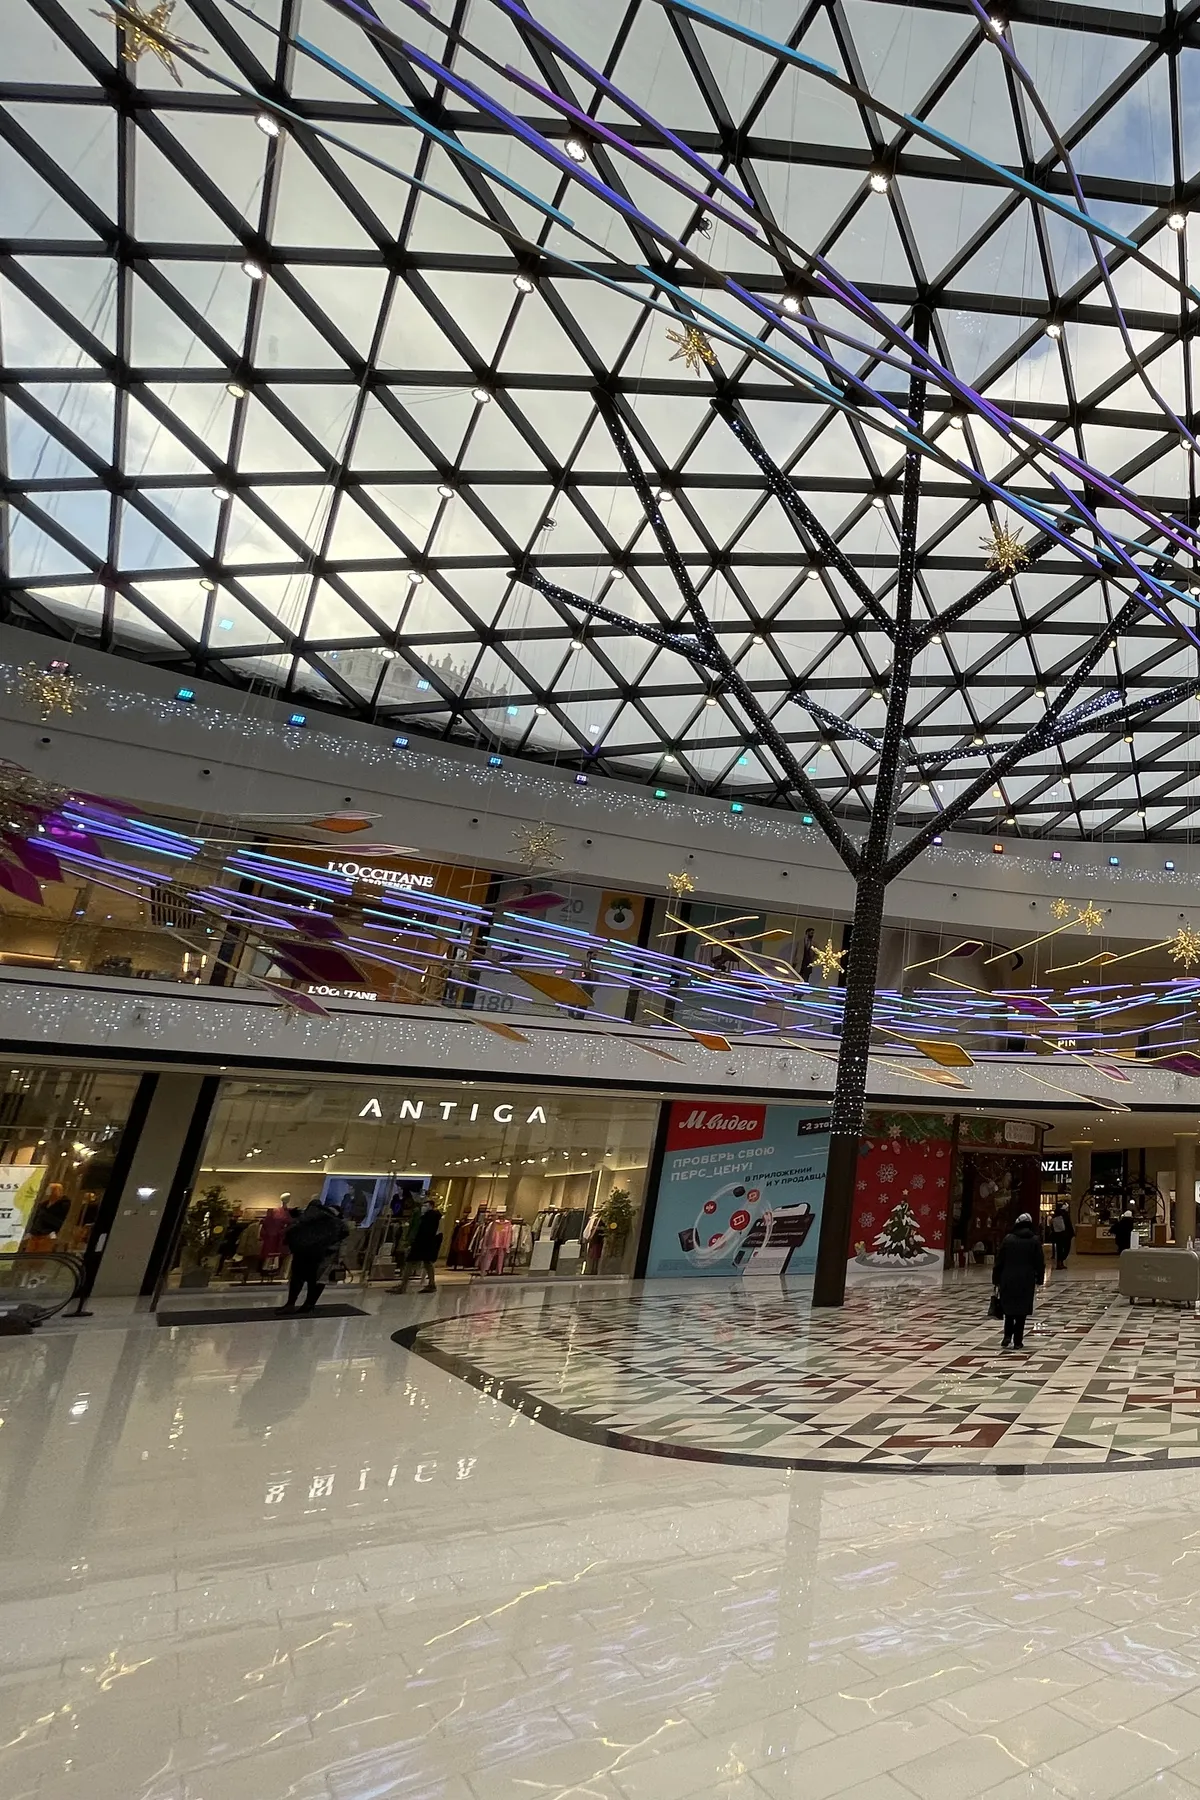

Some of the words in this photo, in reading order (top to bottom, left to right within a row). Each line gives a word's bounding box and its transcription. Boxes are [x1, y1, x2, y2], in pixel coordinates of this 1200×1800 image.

[327, 861, 434, 888] L'OCCITANE
[479, 995, 514, 1012] 180
[358, 1098, 548, 1124] ANTIGA
[678, 1110, 758, 1131] М.видео
[673, 1152, 735, 1169] ПРОВЕРЬ
[737, 1146, 775, 1159] СВОЮ
[670, 1162, 753, 1182] ПЕРС_ЦЕНУ!
[744, 1175, 751, 1183] В
[751, 1166, 813, 1182] ПРИЛОЖЕНИИ
[780, 1172, 827, 1186] ПРОДАВЦА
